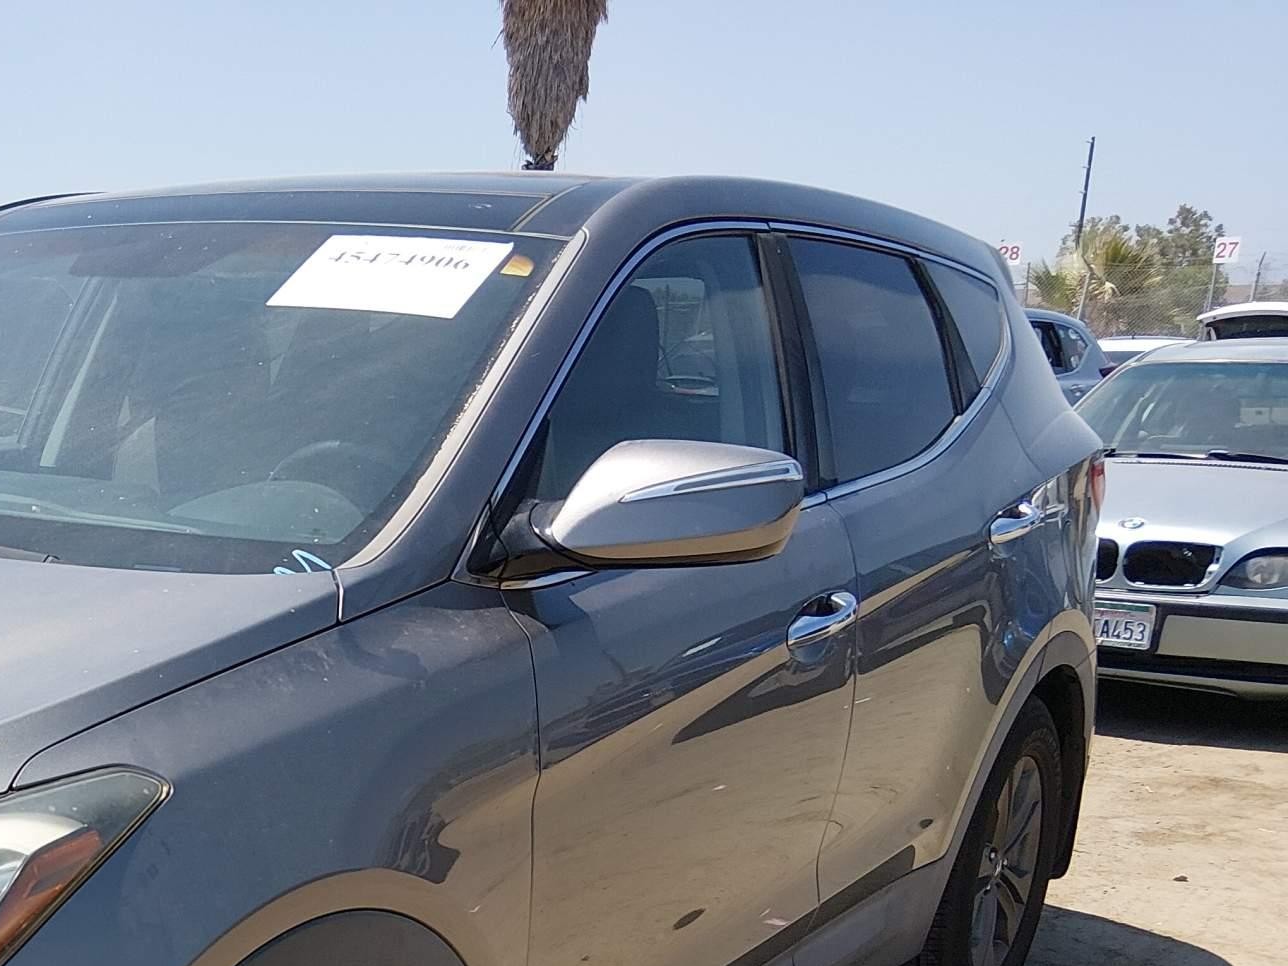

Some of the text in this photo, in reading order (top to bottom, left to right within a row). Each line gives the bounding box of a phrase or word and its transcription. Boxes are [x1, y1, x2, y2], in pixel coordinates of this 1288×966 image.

[999, 245, 1020, 261] 28
[1215, 241, 1240, 259] 27
[327, 250, 472, 271] 45474906
